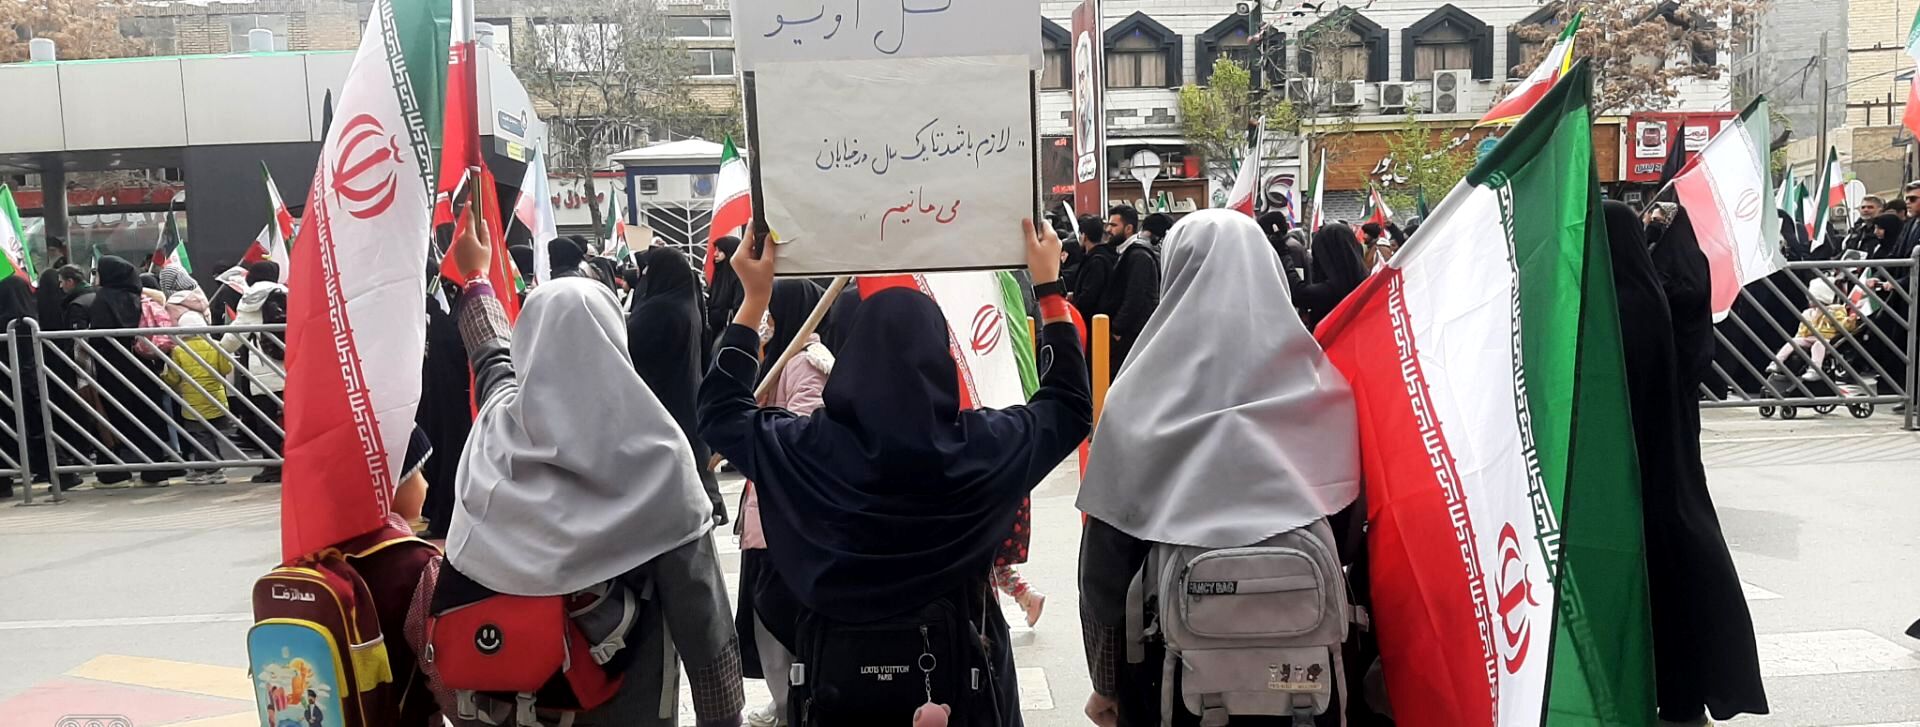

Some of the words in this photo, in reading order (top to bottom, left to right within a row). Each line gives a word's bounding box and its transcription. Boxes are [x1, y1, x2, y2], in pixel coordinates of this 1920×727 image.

[976, 126, 1011, 168] لازم
[860, 666, 879, 674] LOUIS
[880, 665, 910, 674] VUITTON
